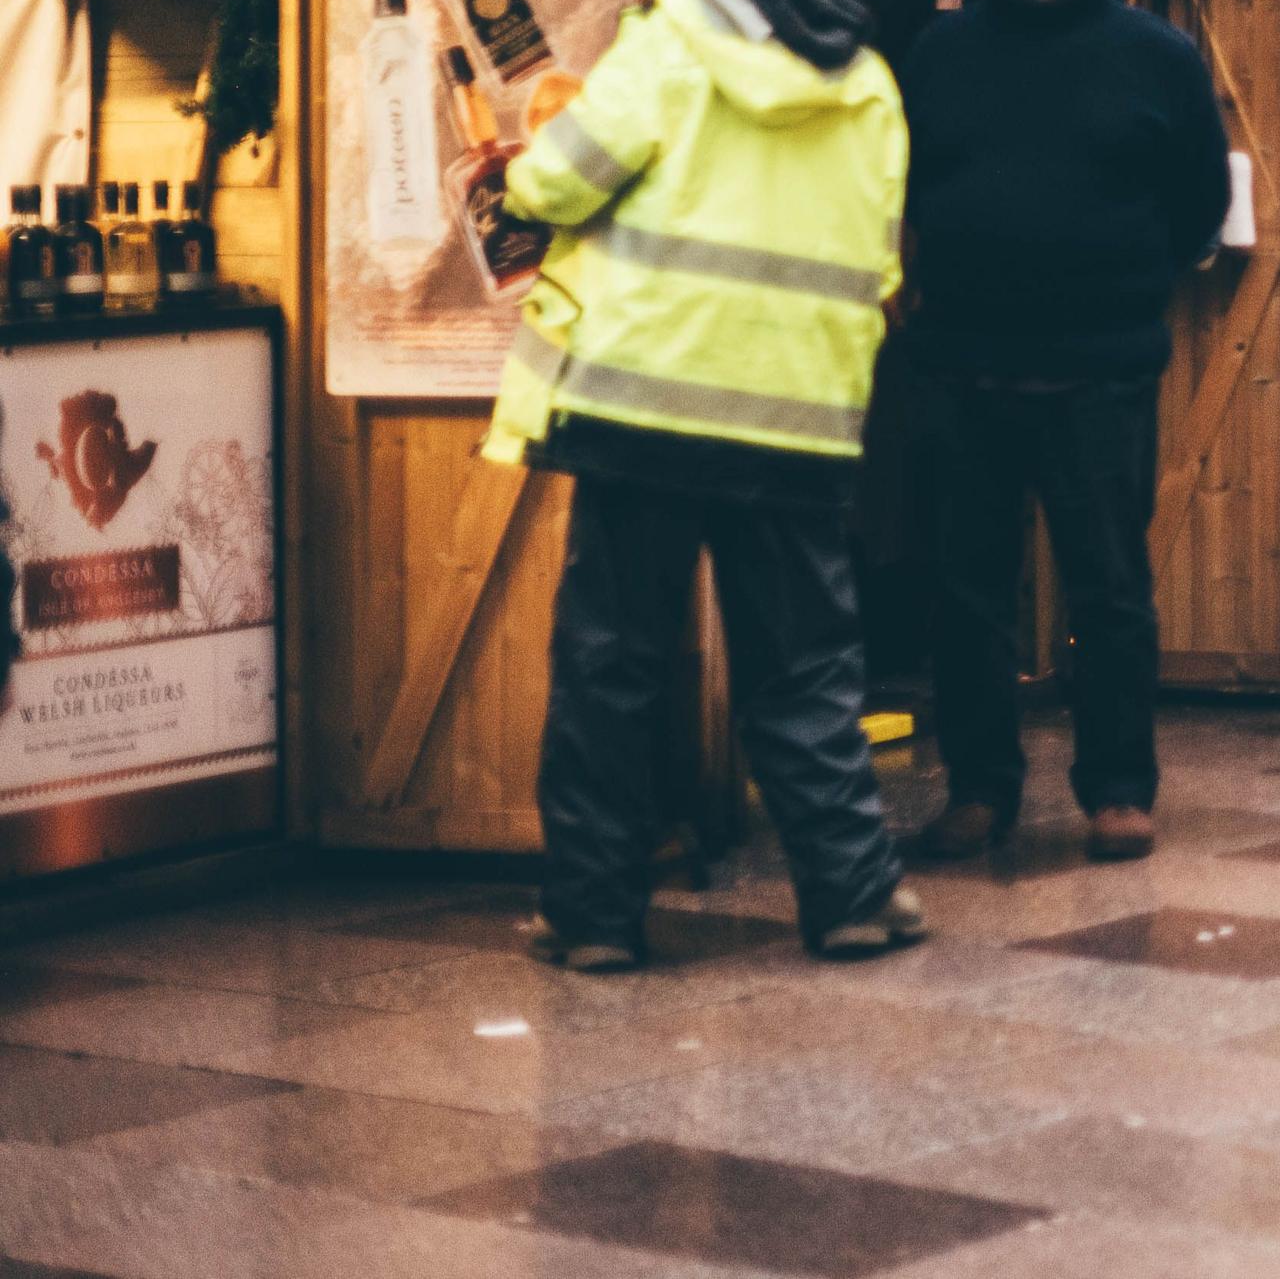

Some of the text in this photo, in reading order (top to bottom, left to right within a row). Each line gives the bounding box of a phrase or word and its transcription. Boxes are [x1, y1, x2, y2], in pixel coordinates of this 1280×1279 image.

[51, 560, 156, 590] CONDESSA
[53, 666, 152, 696] CONDESSA
[19, 682, 187, 724] WELSH LIQUEURS
